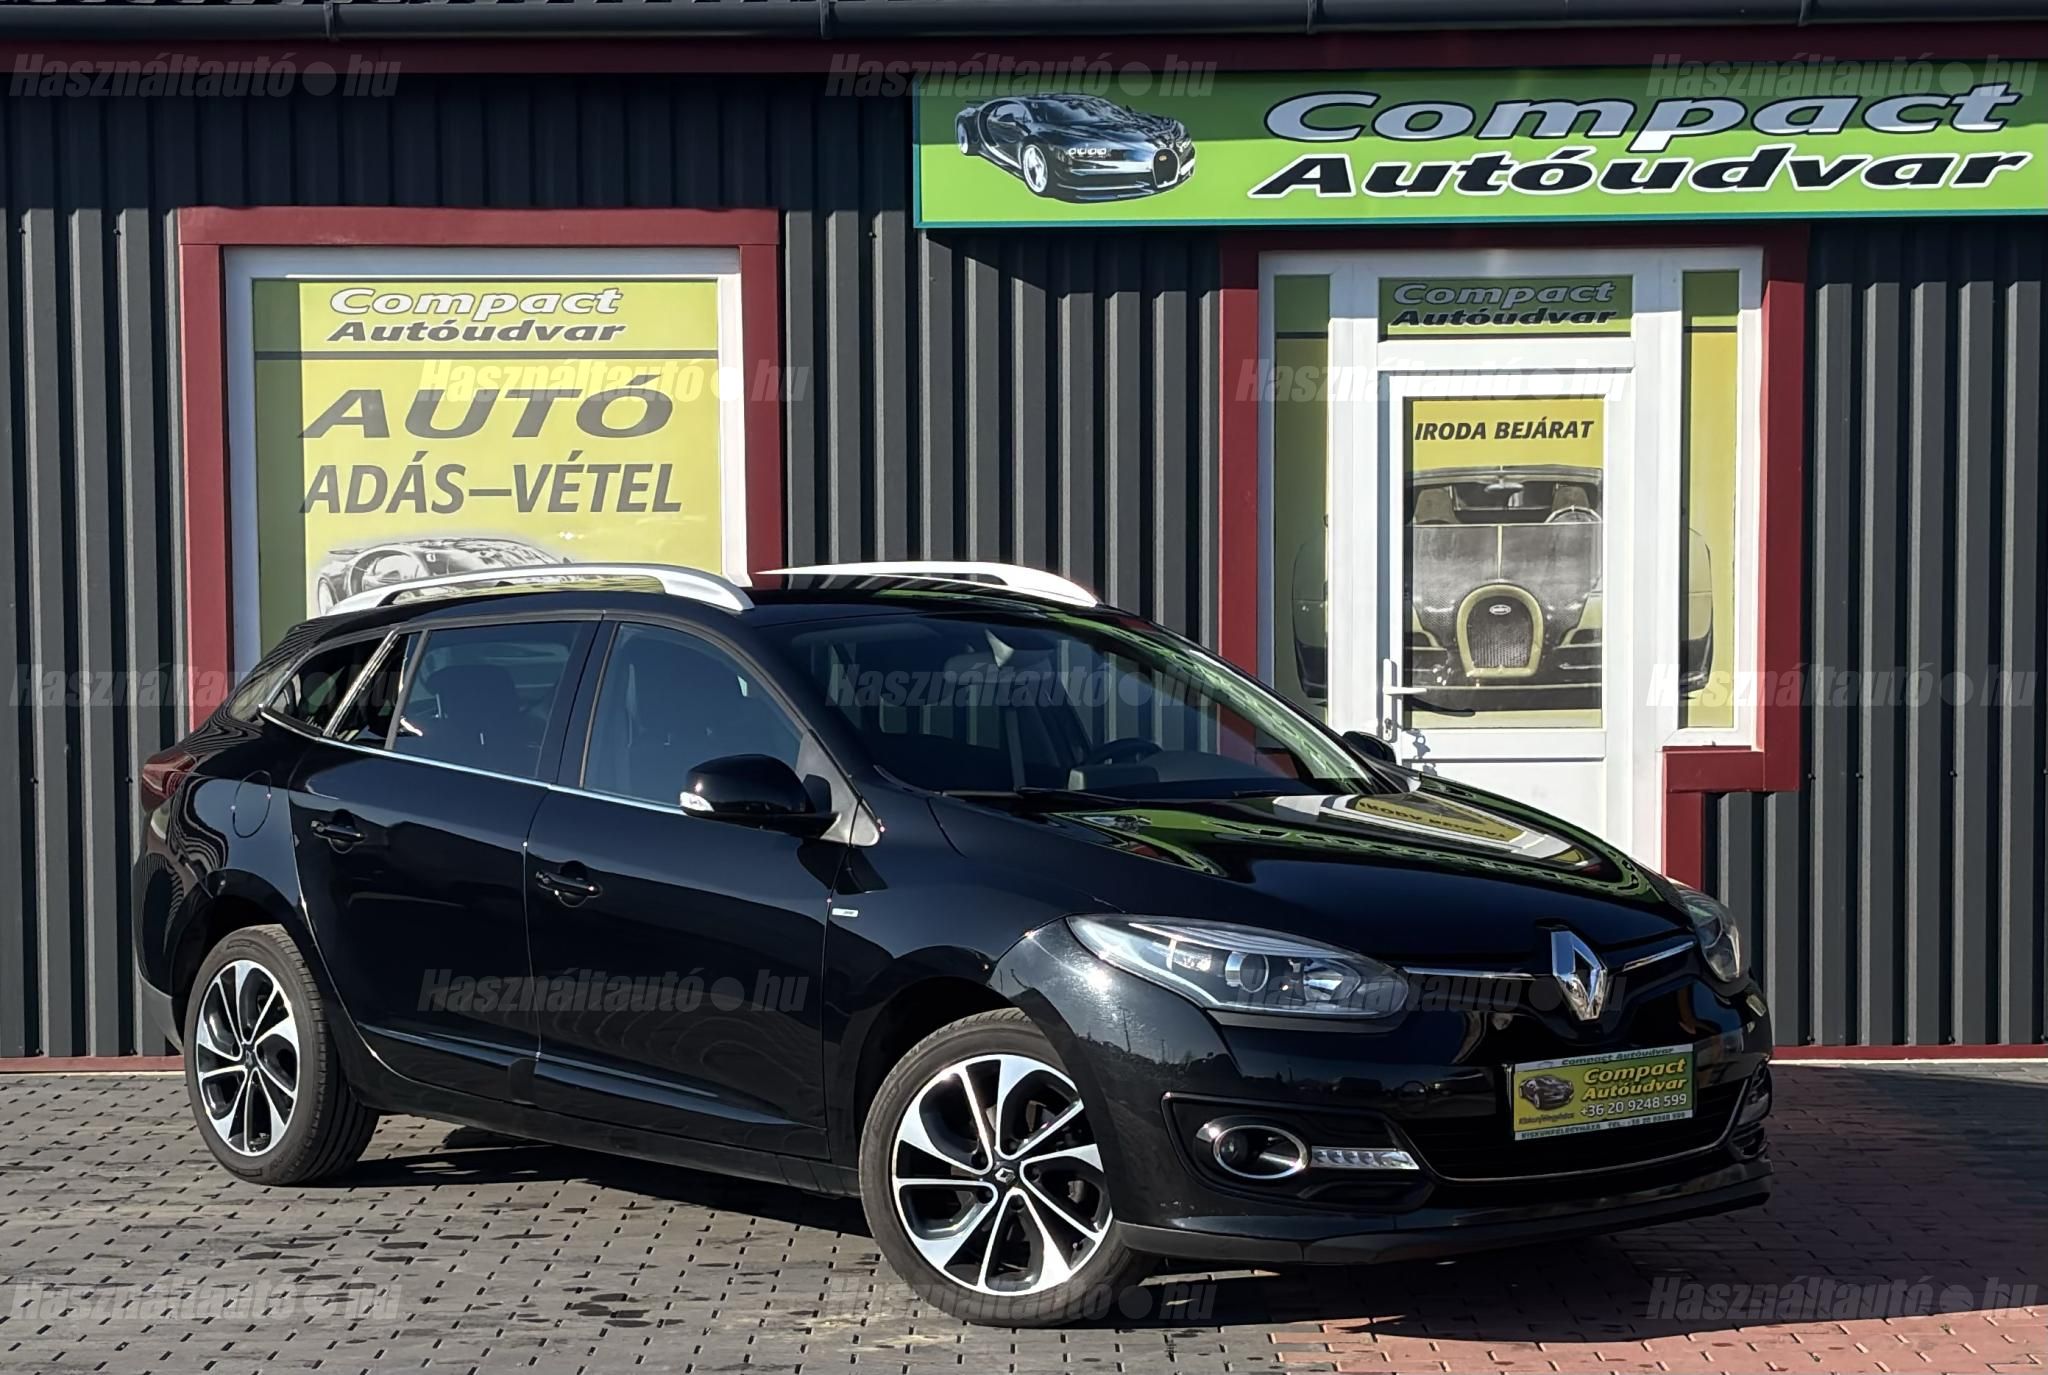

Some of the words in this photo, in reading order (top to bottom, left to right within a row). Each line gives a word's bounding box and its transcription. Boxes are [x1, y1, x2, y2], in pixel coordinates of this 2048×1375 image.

[1264, 81, 2023, 154] Compact
[1246, 142, 2033, 199] Autóudvar
[328, 285, 625, 320] Compact
[1392, 280, 1617, 310] Compact
[324, 316, 628, 344] Autóudvar
[1390, 307, 1618, 328] Autóudvar
[300, 374, 674, 440] AUTÓ
[1413, 419, 1488, 442] IRODA
[1493, 414, 1596, 441] BEJÁRAT
[1583, 1058, 1687, 1084] Compact
[1581, 1078, 1688, 1101] Autóudvar
[1580, 1104, 1604, 1117] +36
[1607, 1102, 1624, 1114] 20
[1628, 1096, 1660, 1111] 9248
[1663, 1094, 1687, 1106] 599
